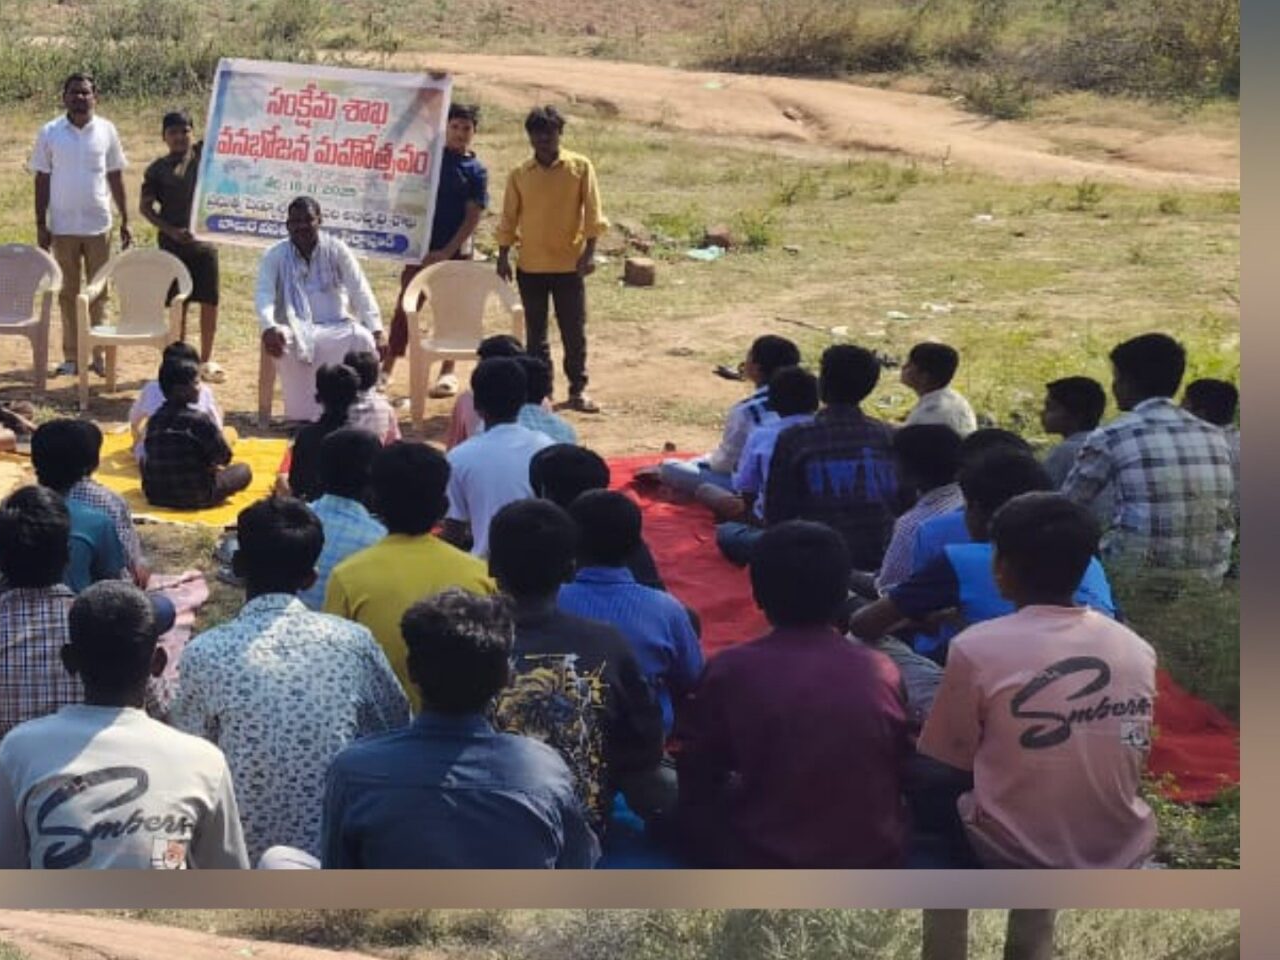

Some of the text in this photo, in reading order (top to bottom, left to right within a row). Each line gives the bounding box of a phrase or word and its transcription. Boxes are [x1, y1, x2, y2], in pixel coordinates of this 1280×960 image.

[267, 81, 389, 129] సంక్షేమ శాఖ
[216, 125, 429, 181] వనభోజన మహోత్సవం
